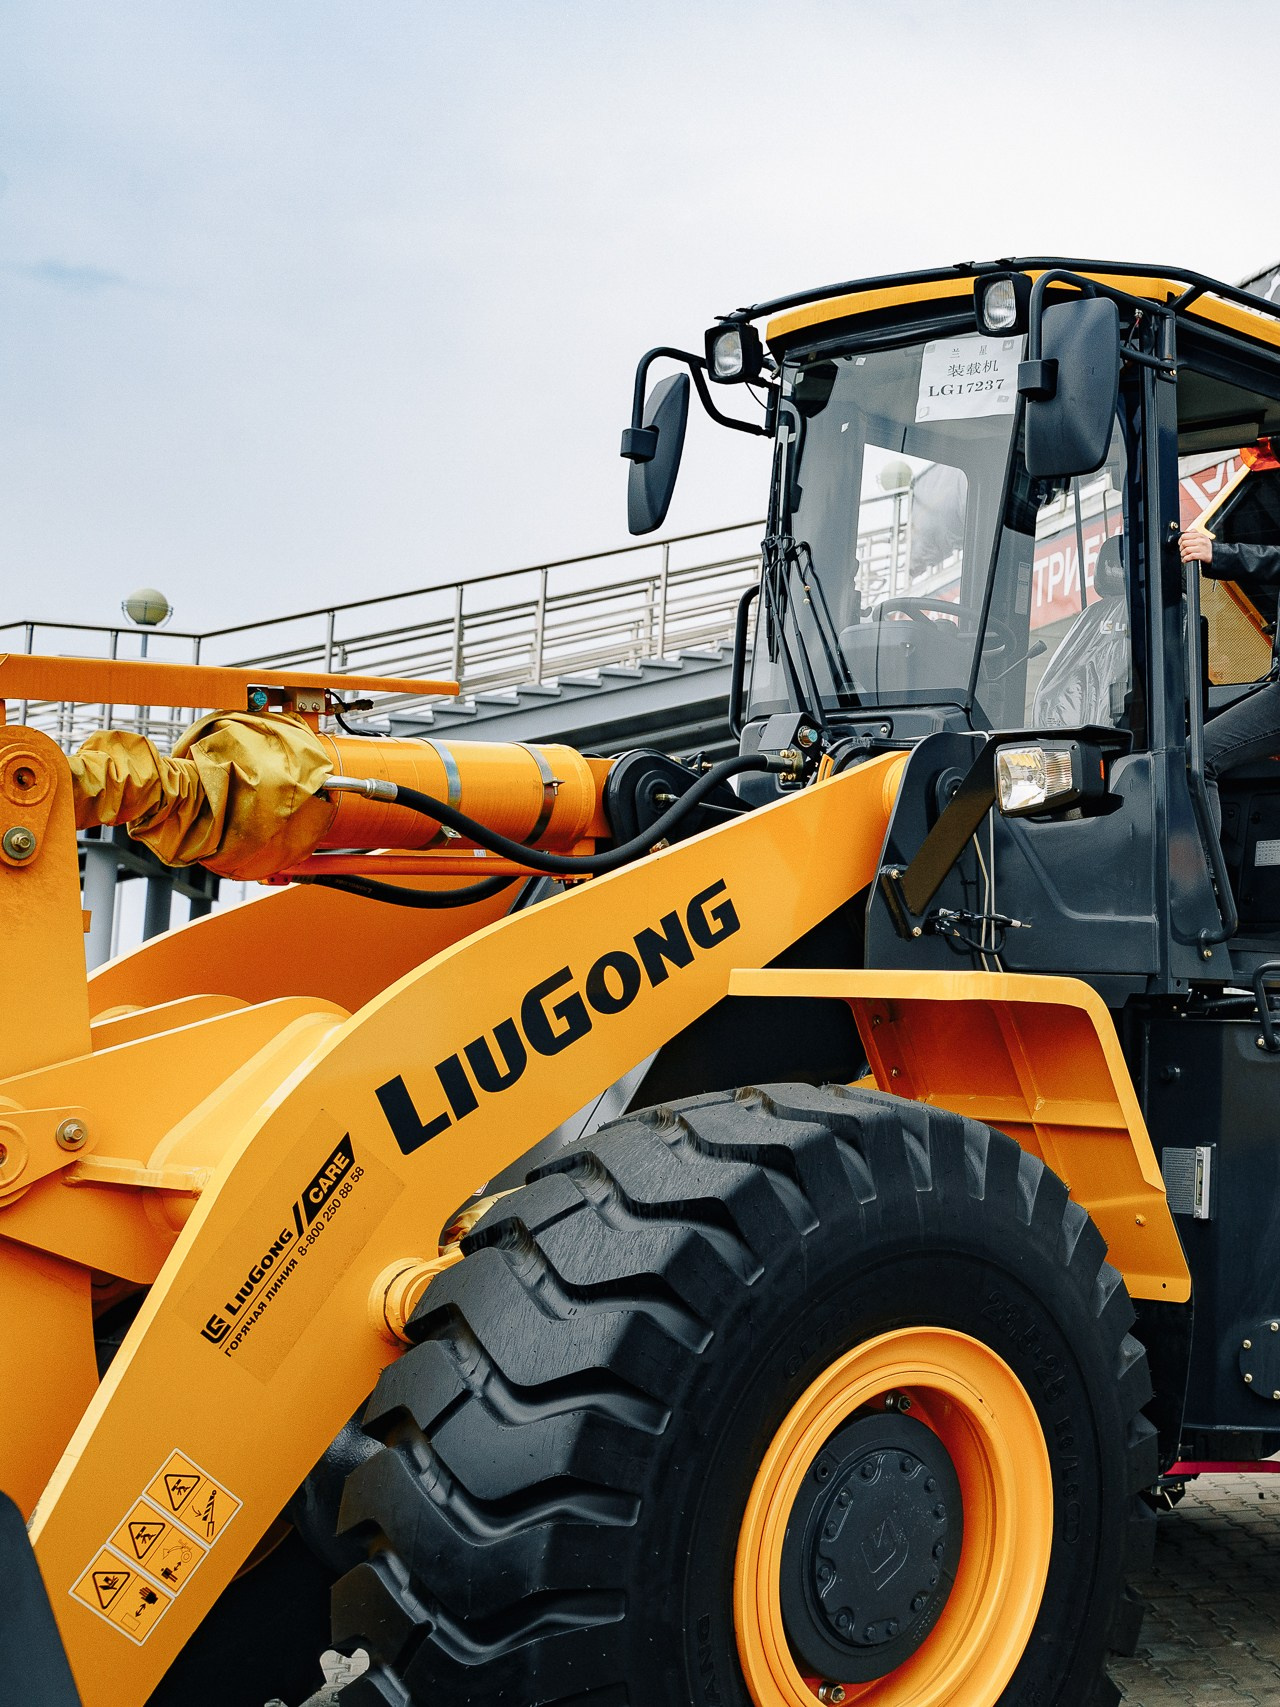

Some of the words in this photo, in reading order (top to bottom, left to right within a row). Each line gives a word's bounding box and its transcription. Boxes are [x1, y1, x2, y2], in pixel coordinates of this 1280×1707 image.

[927, 378, 1005, 397] LG17237
[946, 360, 999, 377] 装载机
[375, 878, 741, 1156] LIUGONG
[224, 1228, 294, 1316] LIUGONG
[308, 1151, 350, 1204] CARE
[224, 1301, 268, 1358] ГОРЯЧАЯ
[265, 1258, 299, 1302] ЛИНИЯ
[297, 1221, 325, 1257] 8-800
[322, 1198, 342, 1223] 250
[338, 1181, 354, 1200] 88
[350, 1166, 365, 1184] 58
